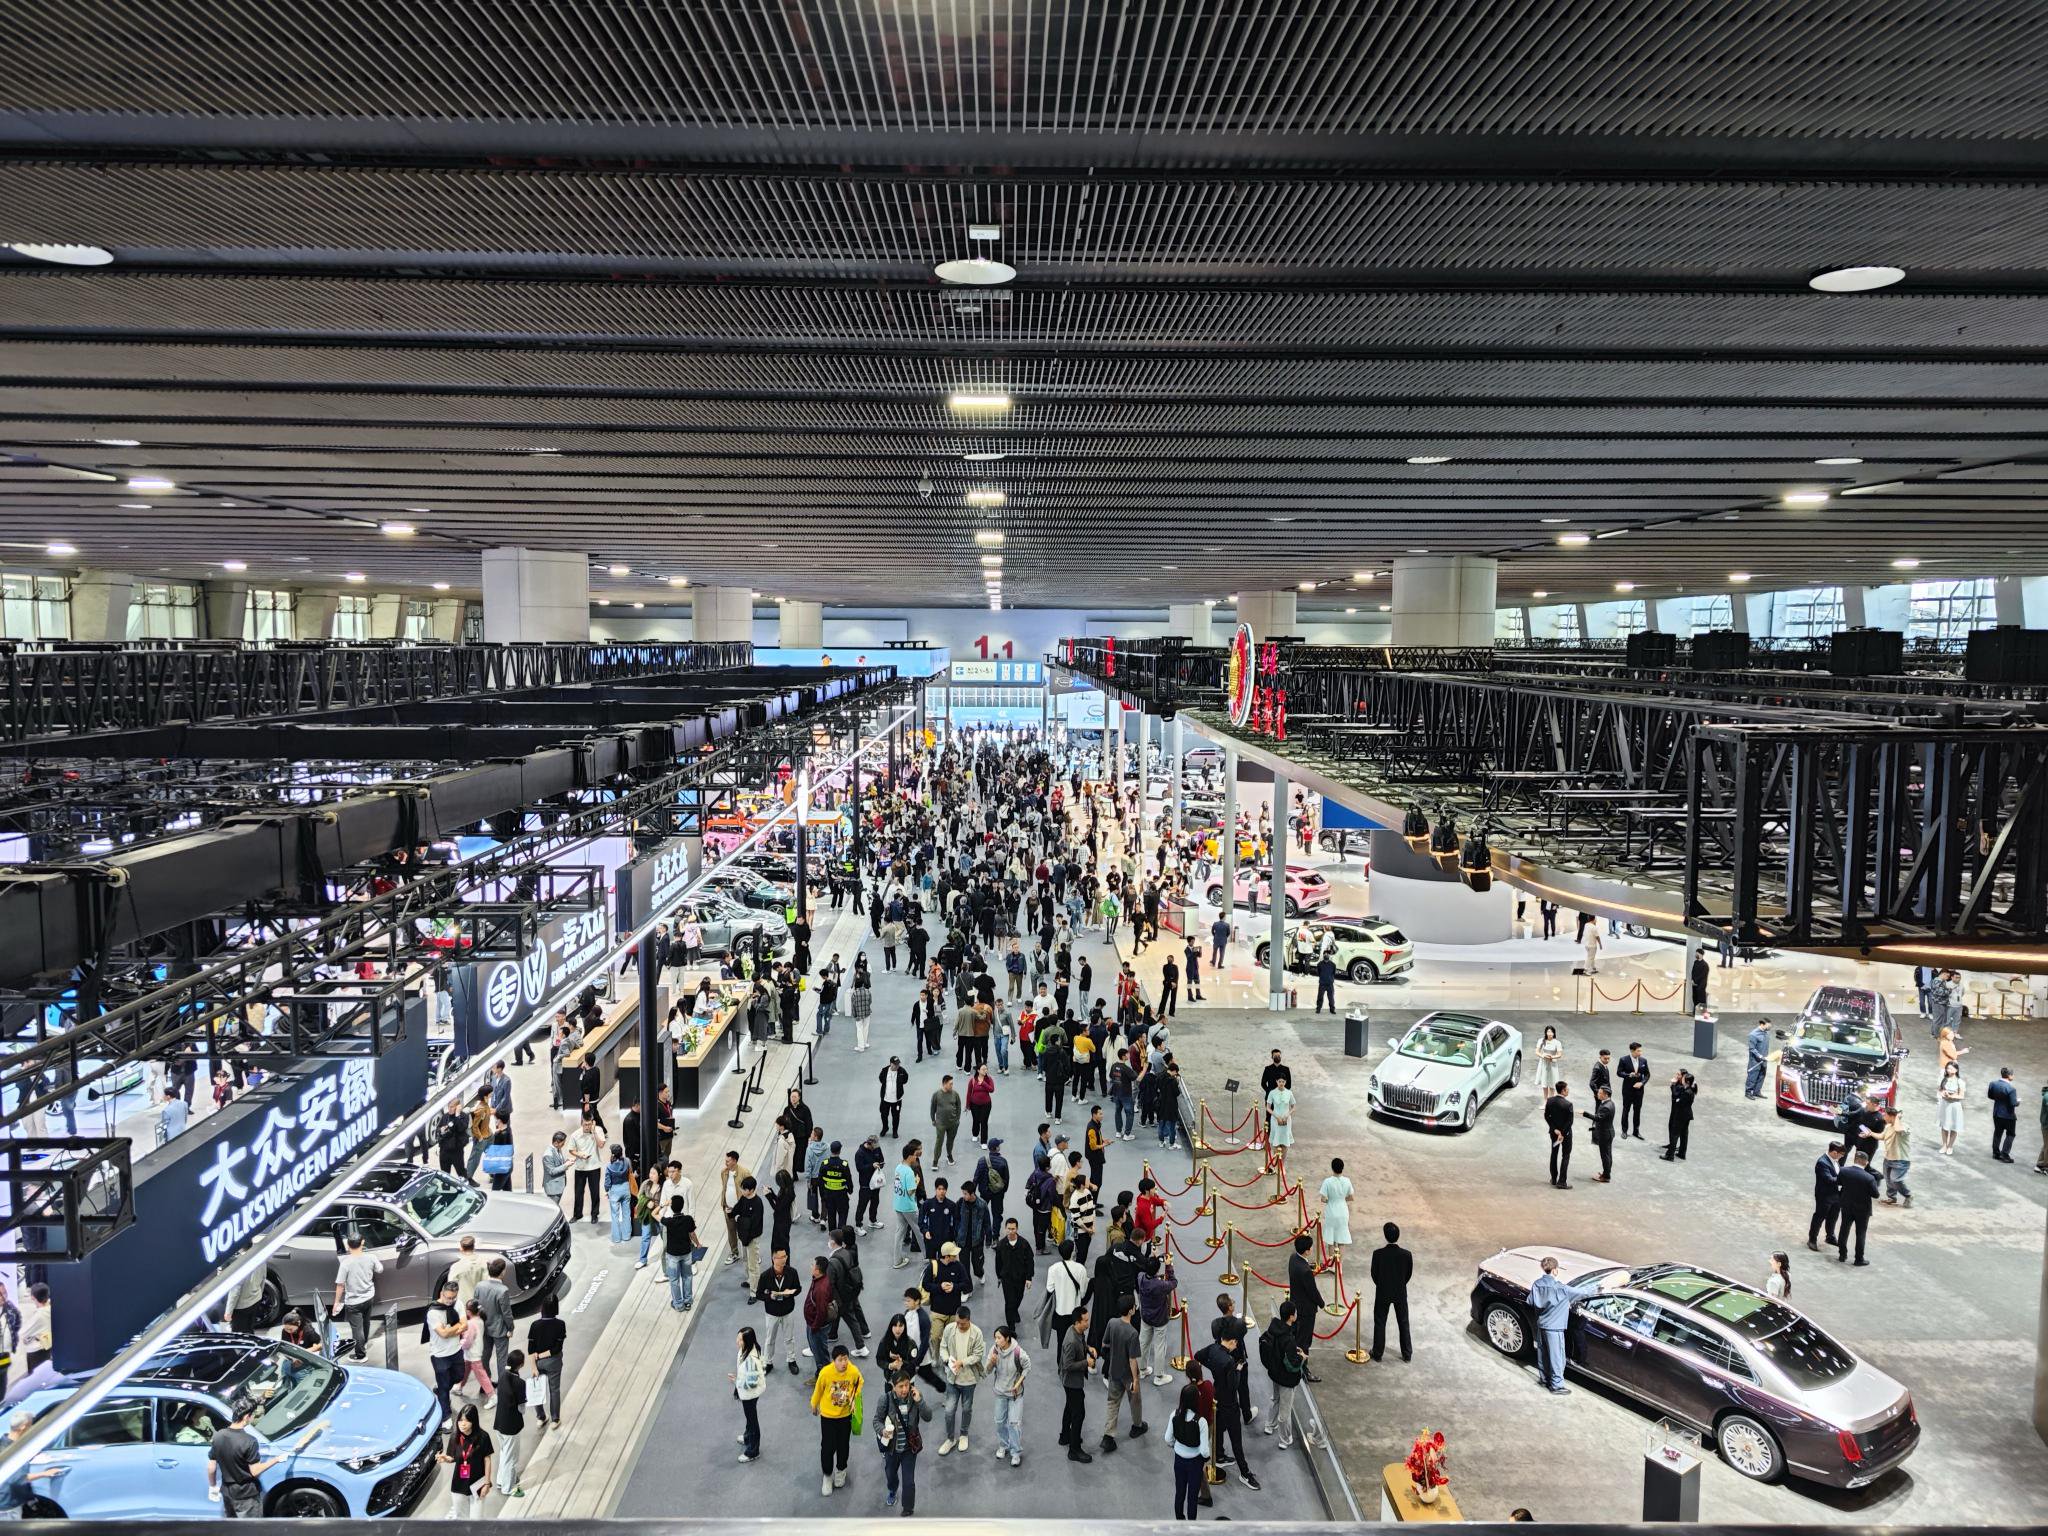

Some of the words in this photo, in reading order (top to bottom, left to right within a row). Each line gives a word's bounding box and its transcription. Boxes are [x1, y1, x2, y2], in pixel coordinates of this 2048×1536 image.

[974, 635, 1013, 659] 1.1
[651, 842, 688, 892] 上汽大众
[199, 1058, 377, 1228] 大众安徽
[200, 1144, 328, 1264] VOLKSWAGEN
[328, 1105, 378, 1166] ANHUI
